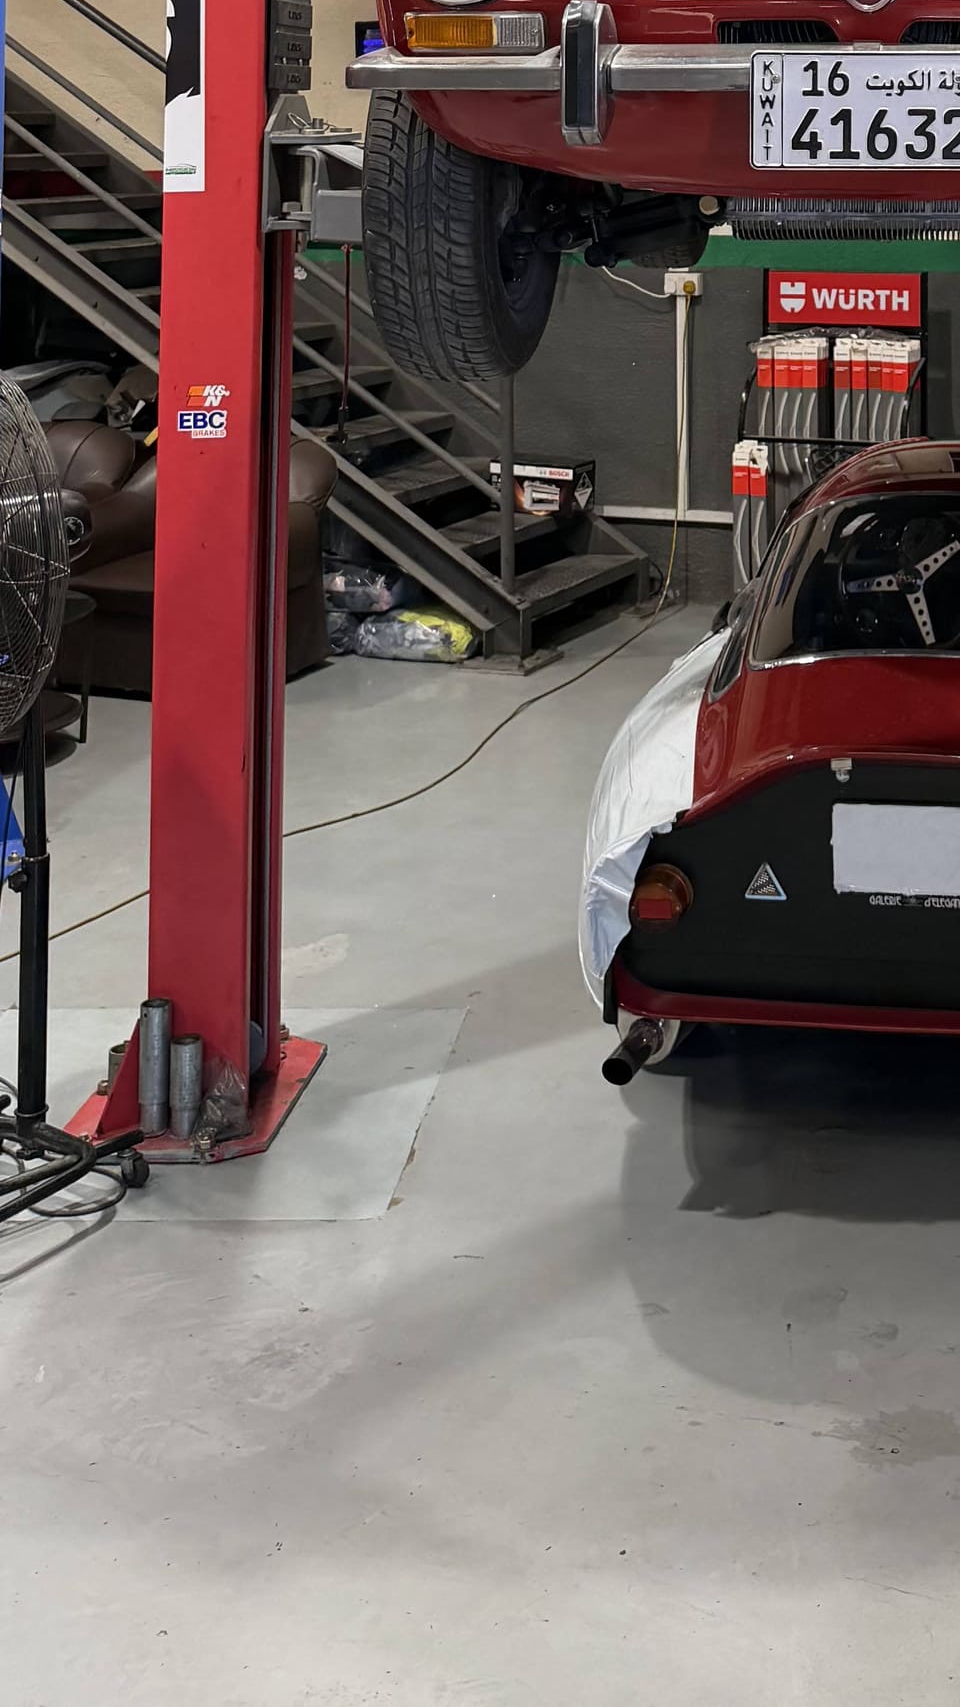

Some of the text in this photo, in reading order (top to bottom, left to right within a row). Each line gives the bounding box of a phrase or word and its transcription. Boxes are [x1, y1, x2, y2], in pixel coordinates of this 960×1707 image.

[801, 60, 850, 97] 16
[865, 69, 932, 97] الكويت
[760, 60, 776, 161] KUWAIT
[811, 287, 910, 312] WÜRTH
[179, 411, 226, 430] EBC
[192, 429, 226, 437] BRAKES
[548, 468, 570, 478] BOSCH
